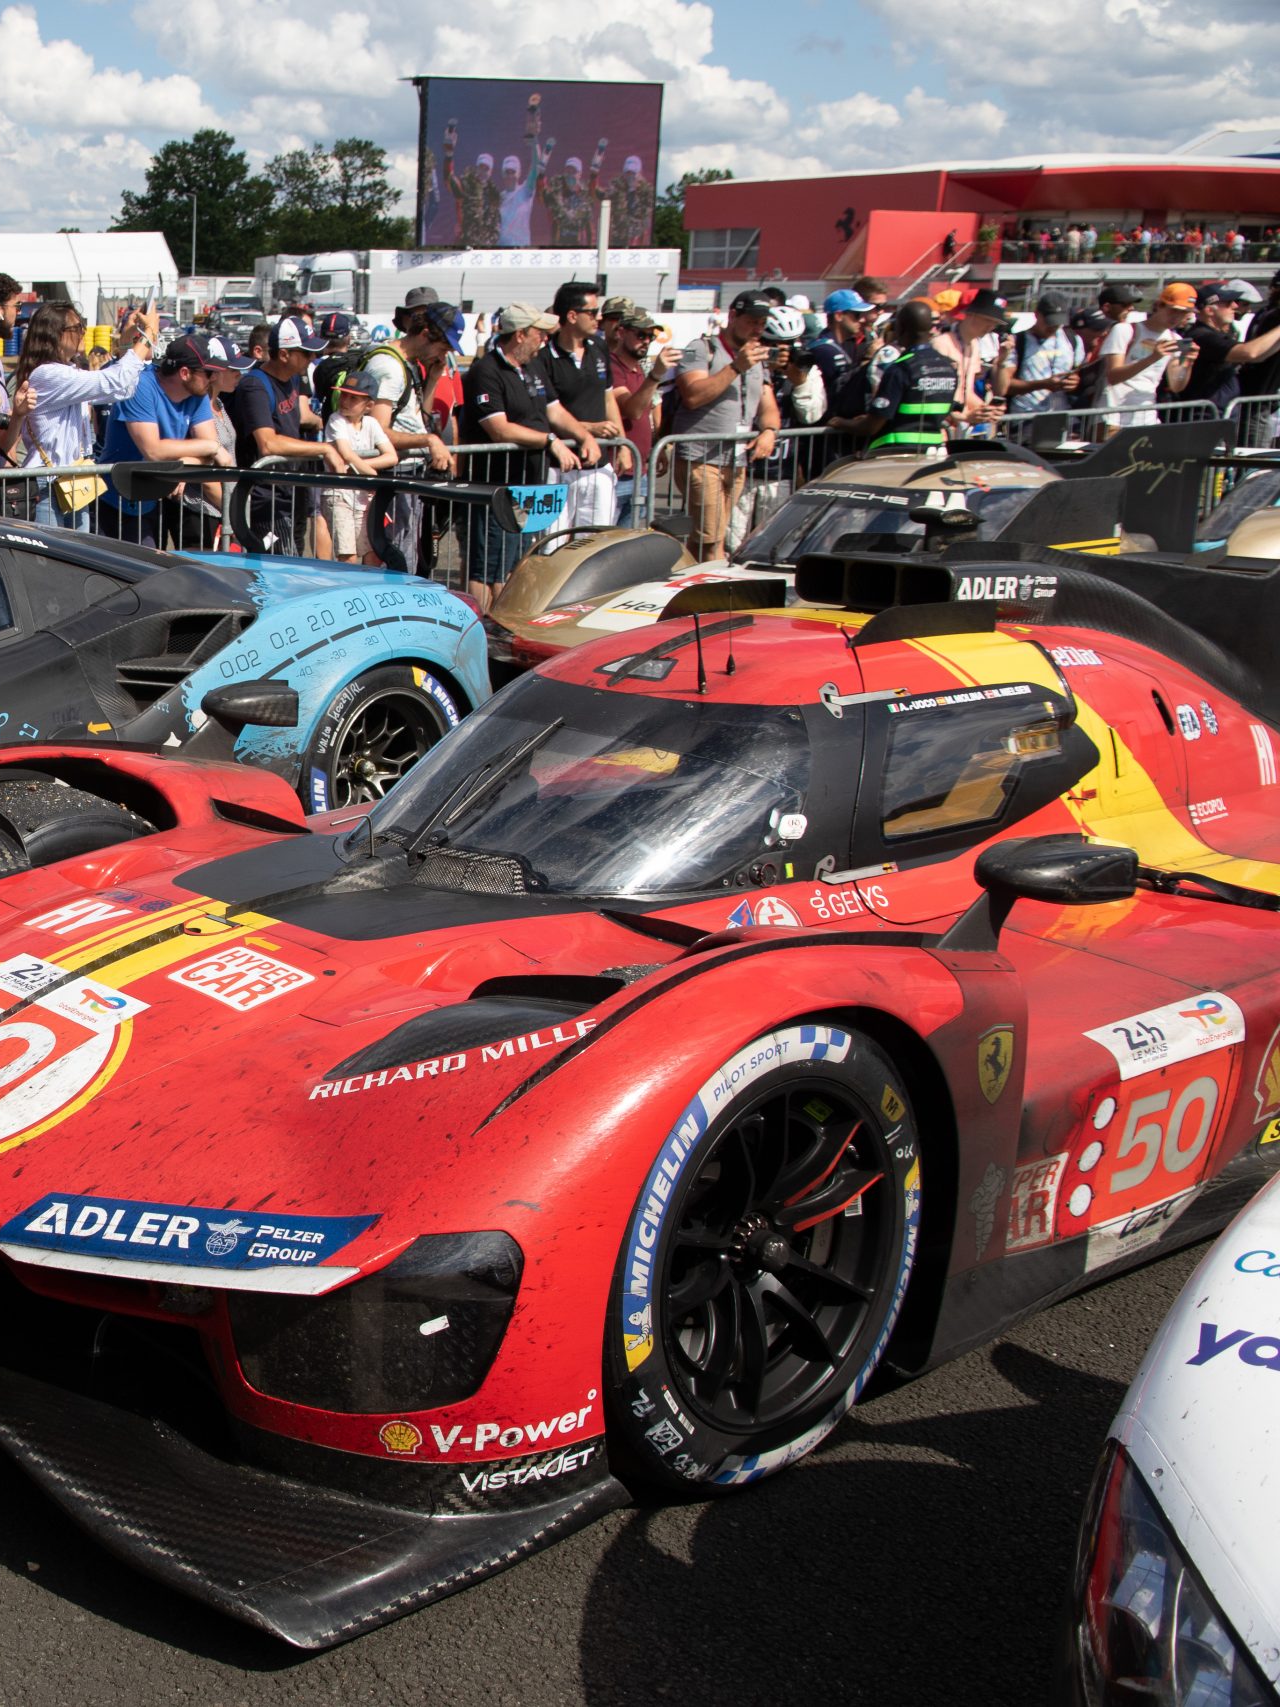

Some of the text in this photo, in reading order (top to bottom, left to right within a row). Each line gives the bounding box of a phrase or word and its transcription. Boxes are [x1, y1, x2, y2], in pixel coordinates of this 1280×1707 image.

[6, 534, 48, 548] SEGAL
[375, 591, 405, 609] 200
[957, 577, 1018, 600] ADLER
[307, 609, 335, 632] 2.0
[343, 597, 367, 617] 20
[270, 626, 300, 649] 0.2
[220, 649, 262, 679] 0.02
[22, 898, 133, 935] HY
[828, 886, 889, 916] GENYS
[181, 961, 276, 1008] CAR
[216, 950, 303, 989] HYPER
[308, 1018, 597, 1100] RICHARD MILLE
[713, 1040, 790, 1102] PILOT SPORT
[1110, 1076, 1219, 1194] 50
[631, 1112, 700, 1299] MICHELIN
[24, 1202, 200, 1249] ADLER
[256, 1224, 325, 1244] PELZER
[247, 1243, 317, 1263] GROUP
[430, 1405, 593, 1453] V-Power
[459, 1447, 595, 1492] VISTAJET
